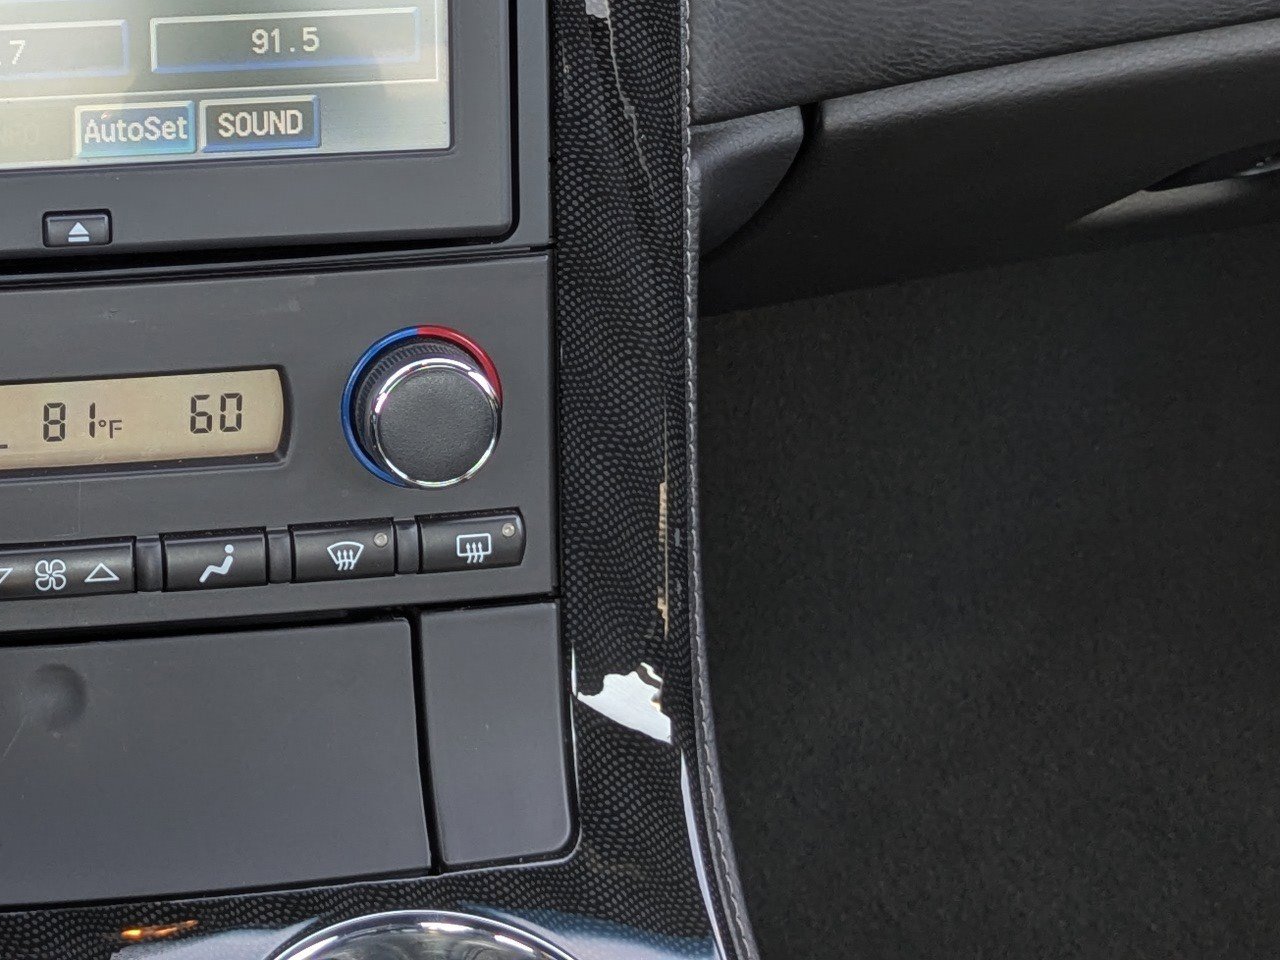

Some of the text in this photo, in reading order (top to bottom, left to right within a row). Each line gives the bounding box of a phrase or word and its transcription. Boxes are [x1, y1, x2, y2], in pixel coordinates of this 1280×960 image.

[251, 27, 320, 54] 91.5
[84, 115, 188, 144] AutoSet
[218, 109, 303, 138] SOUND
[190, 392, 243, 435] 60
